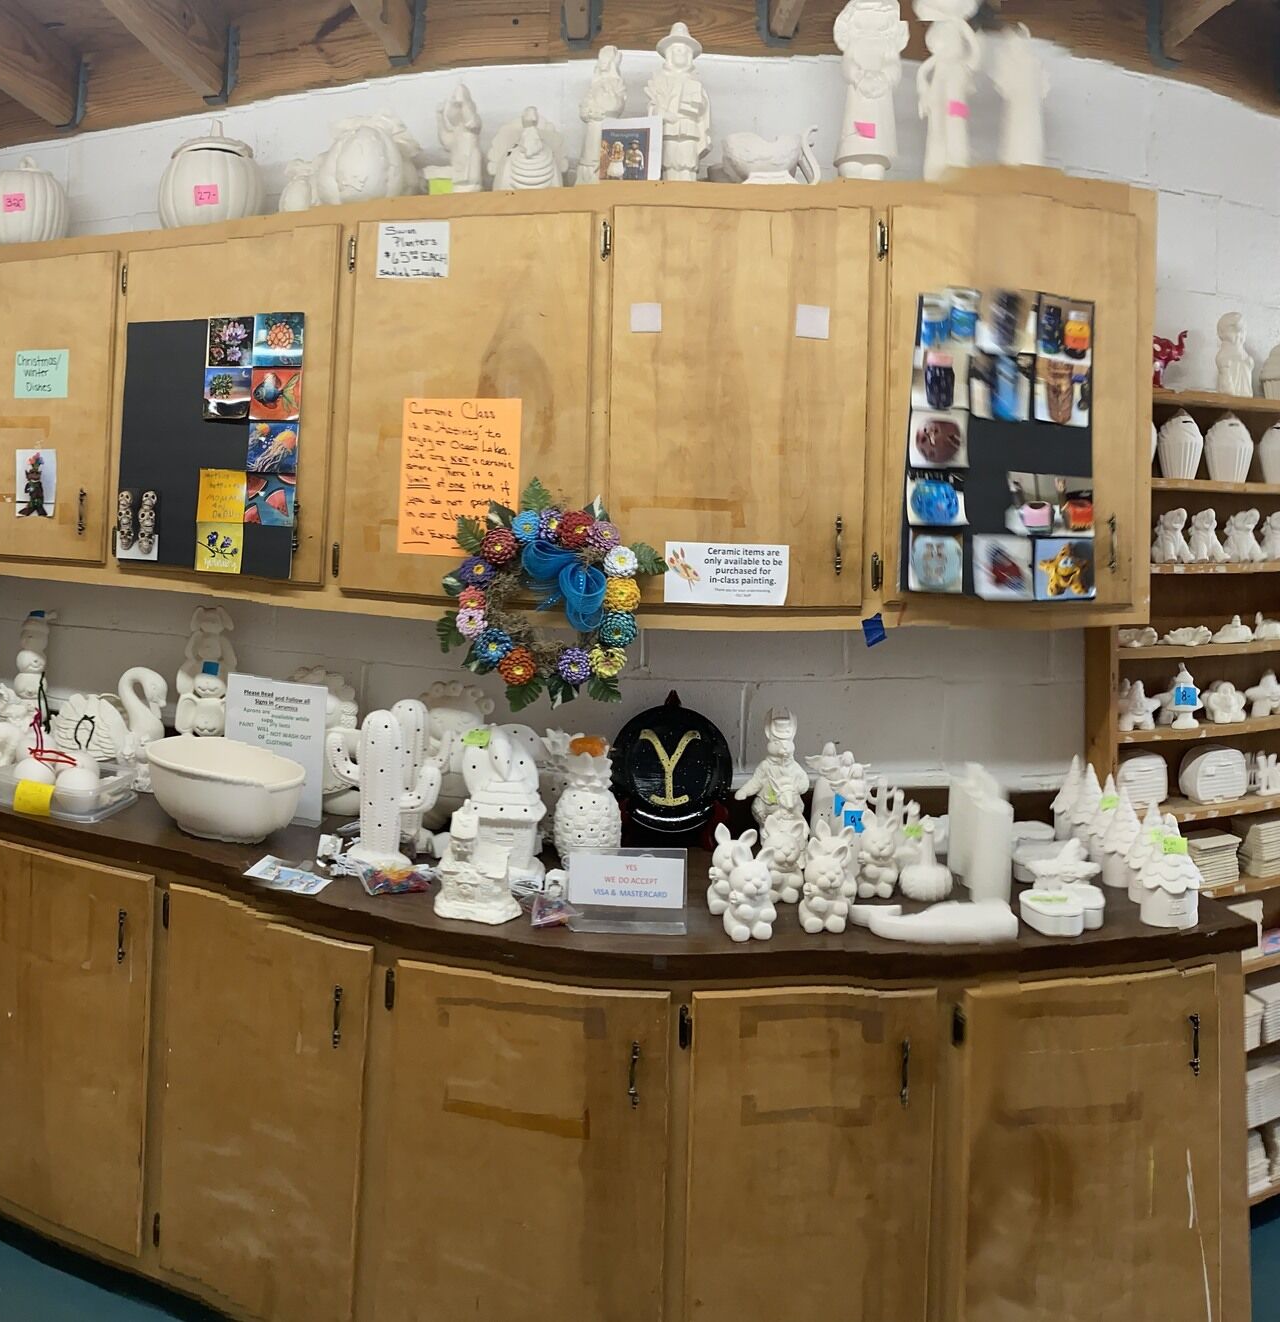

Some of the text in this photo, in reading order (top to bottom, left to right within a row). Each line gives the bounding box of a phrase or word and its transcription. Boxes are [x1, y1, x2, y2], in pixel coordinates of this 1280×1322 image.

[461, 402, 495, 420] Class
[485, 428, 501, 438] to
[450, 440, 478, 450] Ocean
[708, 547, 740, 556] Ceramic
[743, 548, 764, 556] items
[704, 556, 782, 566] only available to be
[716, 567, 771, 576] purchased for
[709, 576, 776, 586] in-class painting.
[1182, 690, 1190, 700] 8-
[639, 729, 701, 806] Y
[619, 890, 668, 898] MASTERCARD
